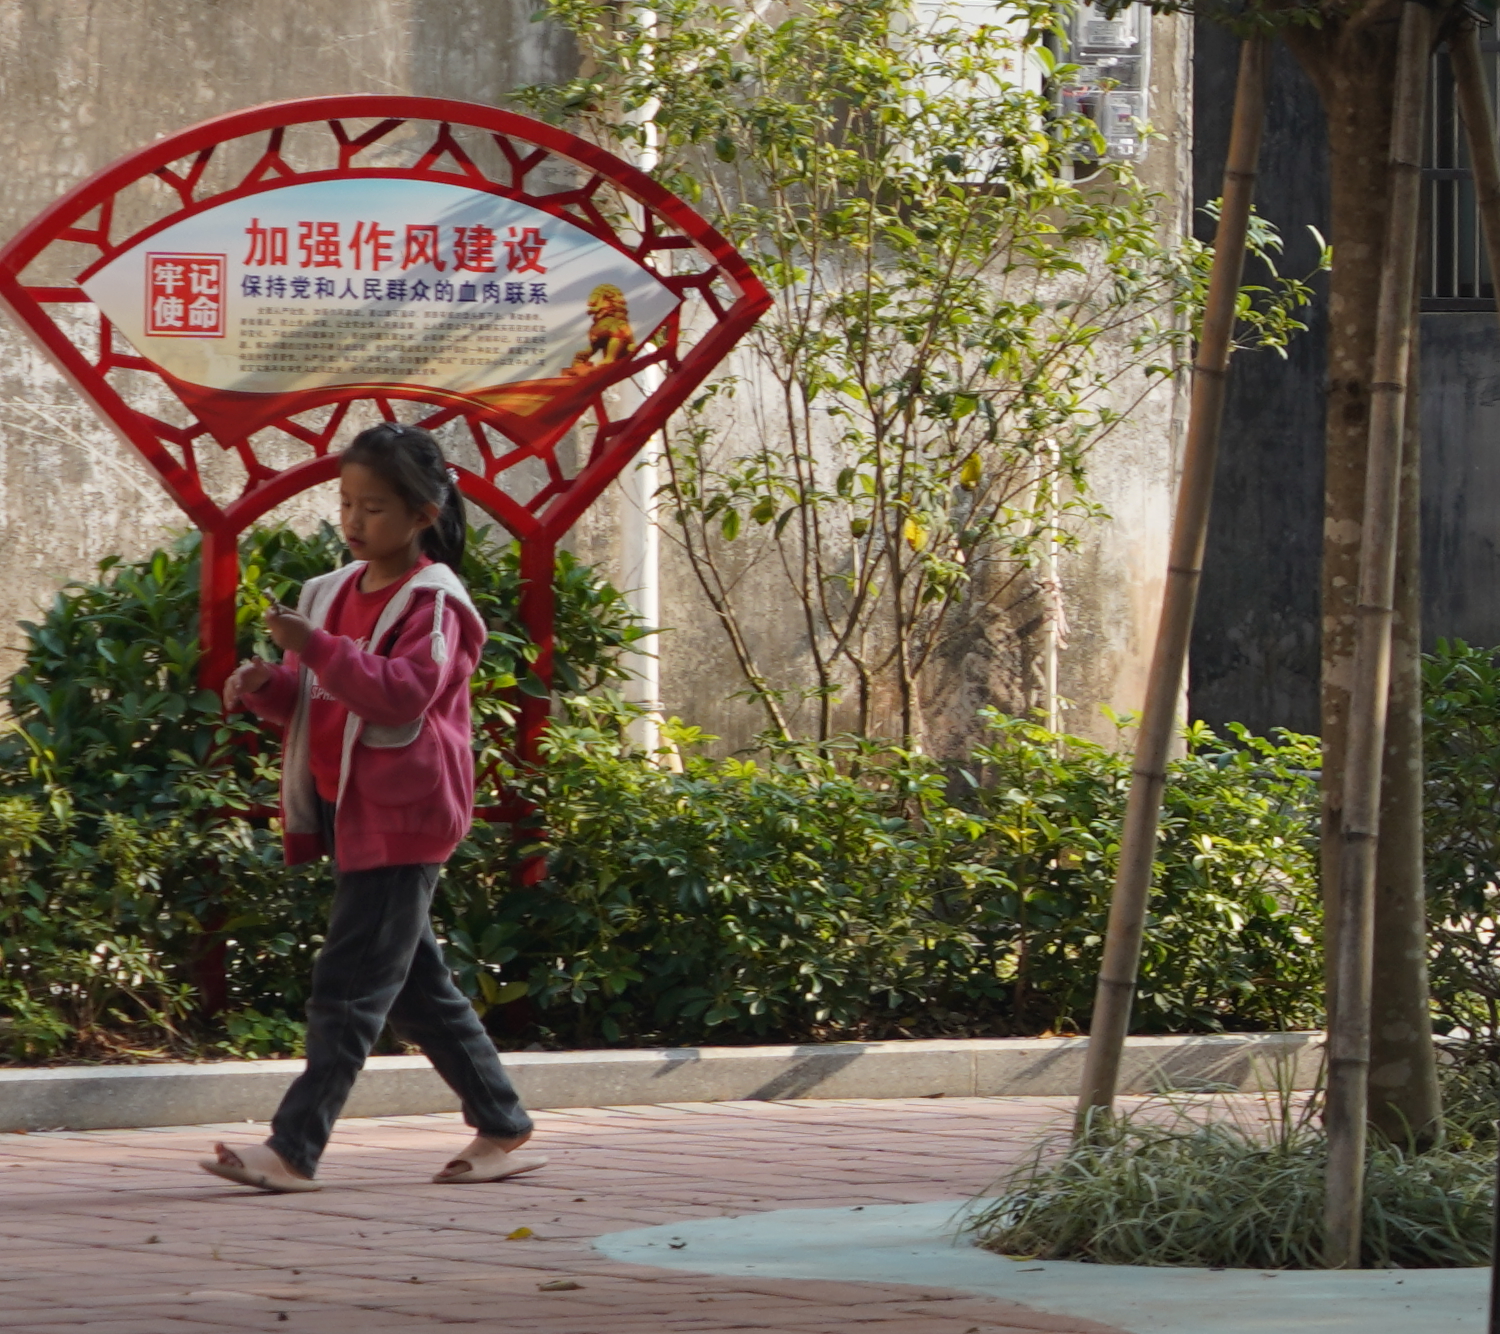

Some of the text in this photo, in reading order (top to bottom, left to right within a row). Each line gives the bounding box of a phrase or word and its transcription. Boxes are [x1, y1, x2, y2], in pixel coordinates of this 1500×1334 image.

[242, 217, 549, 274] 加强作风建设
[153, 262, 219, 295] 牢记
[241, 274, 549, 305] 保持党和人民群众的血肉联系
[153, 296, 219, 329] 使命
